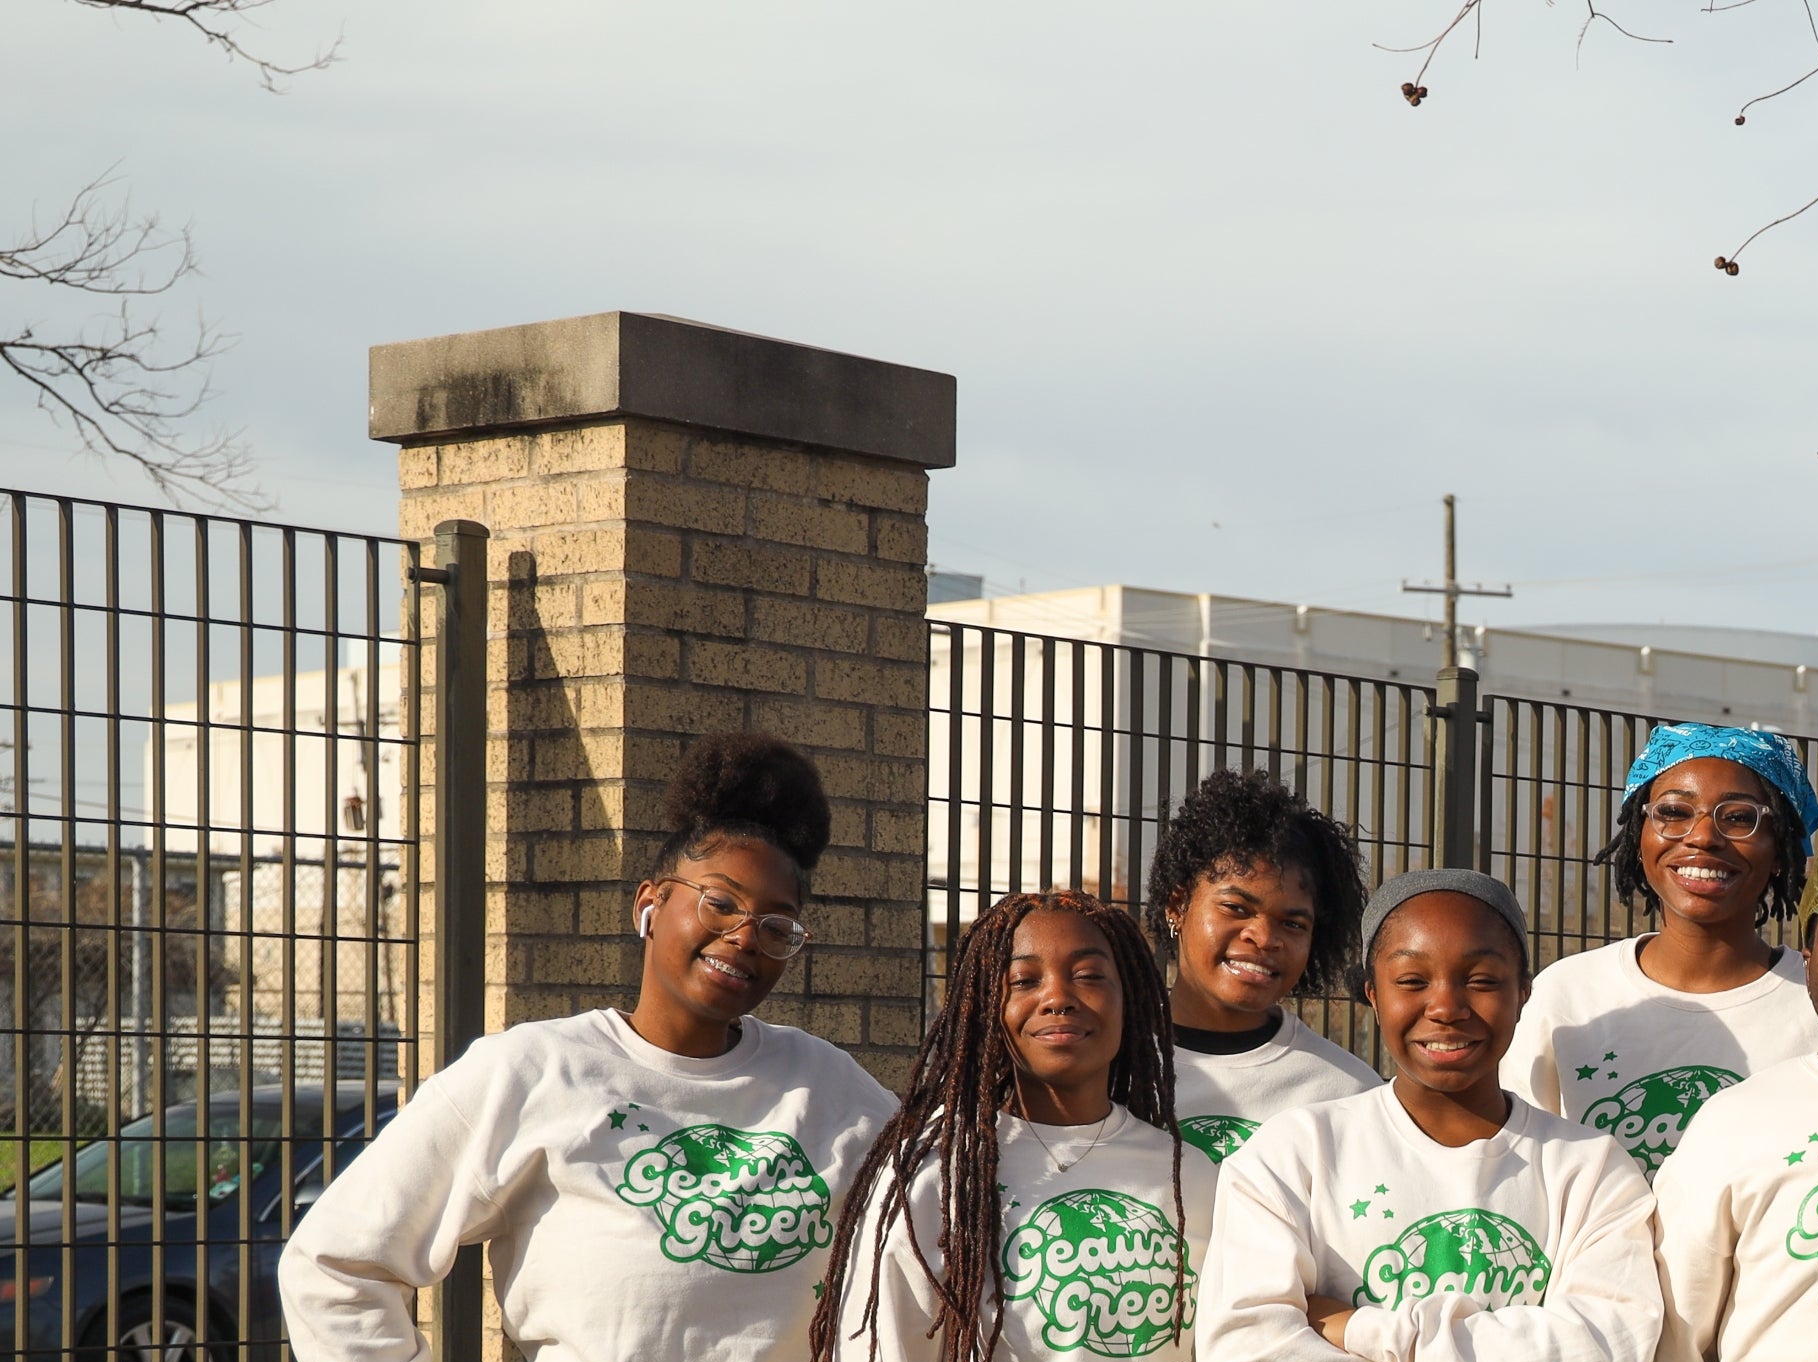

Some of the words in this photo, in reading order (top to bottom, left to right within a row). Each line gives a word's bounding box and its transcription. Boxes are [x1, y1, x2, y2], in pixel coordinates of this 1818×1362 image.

[1582, 1098, 1684, 1150] Gea
[617, 1150, 813, 1205] Geaux
[661, 1199, 831, 1261] Green
[1003, 1226, 1181, 1299] Geaux
[1043, 1279, 1196, 1349] Green
